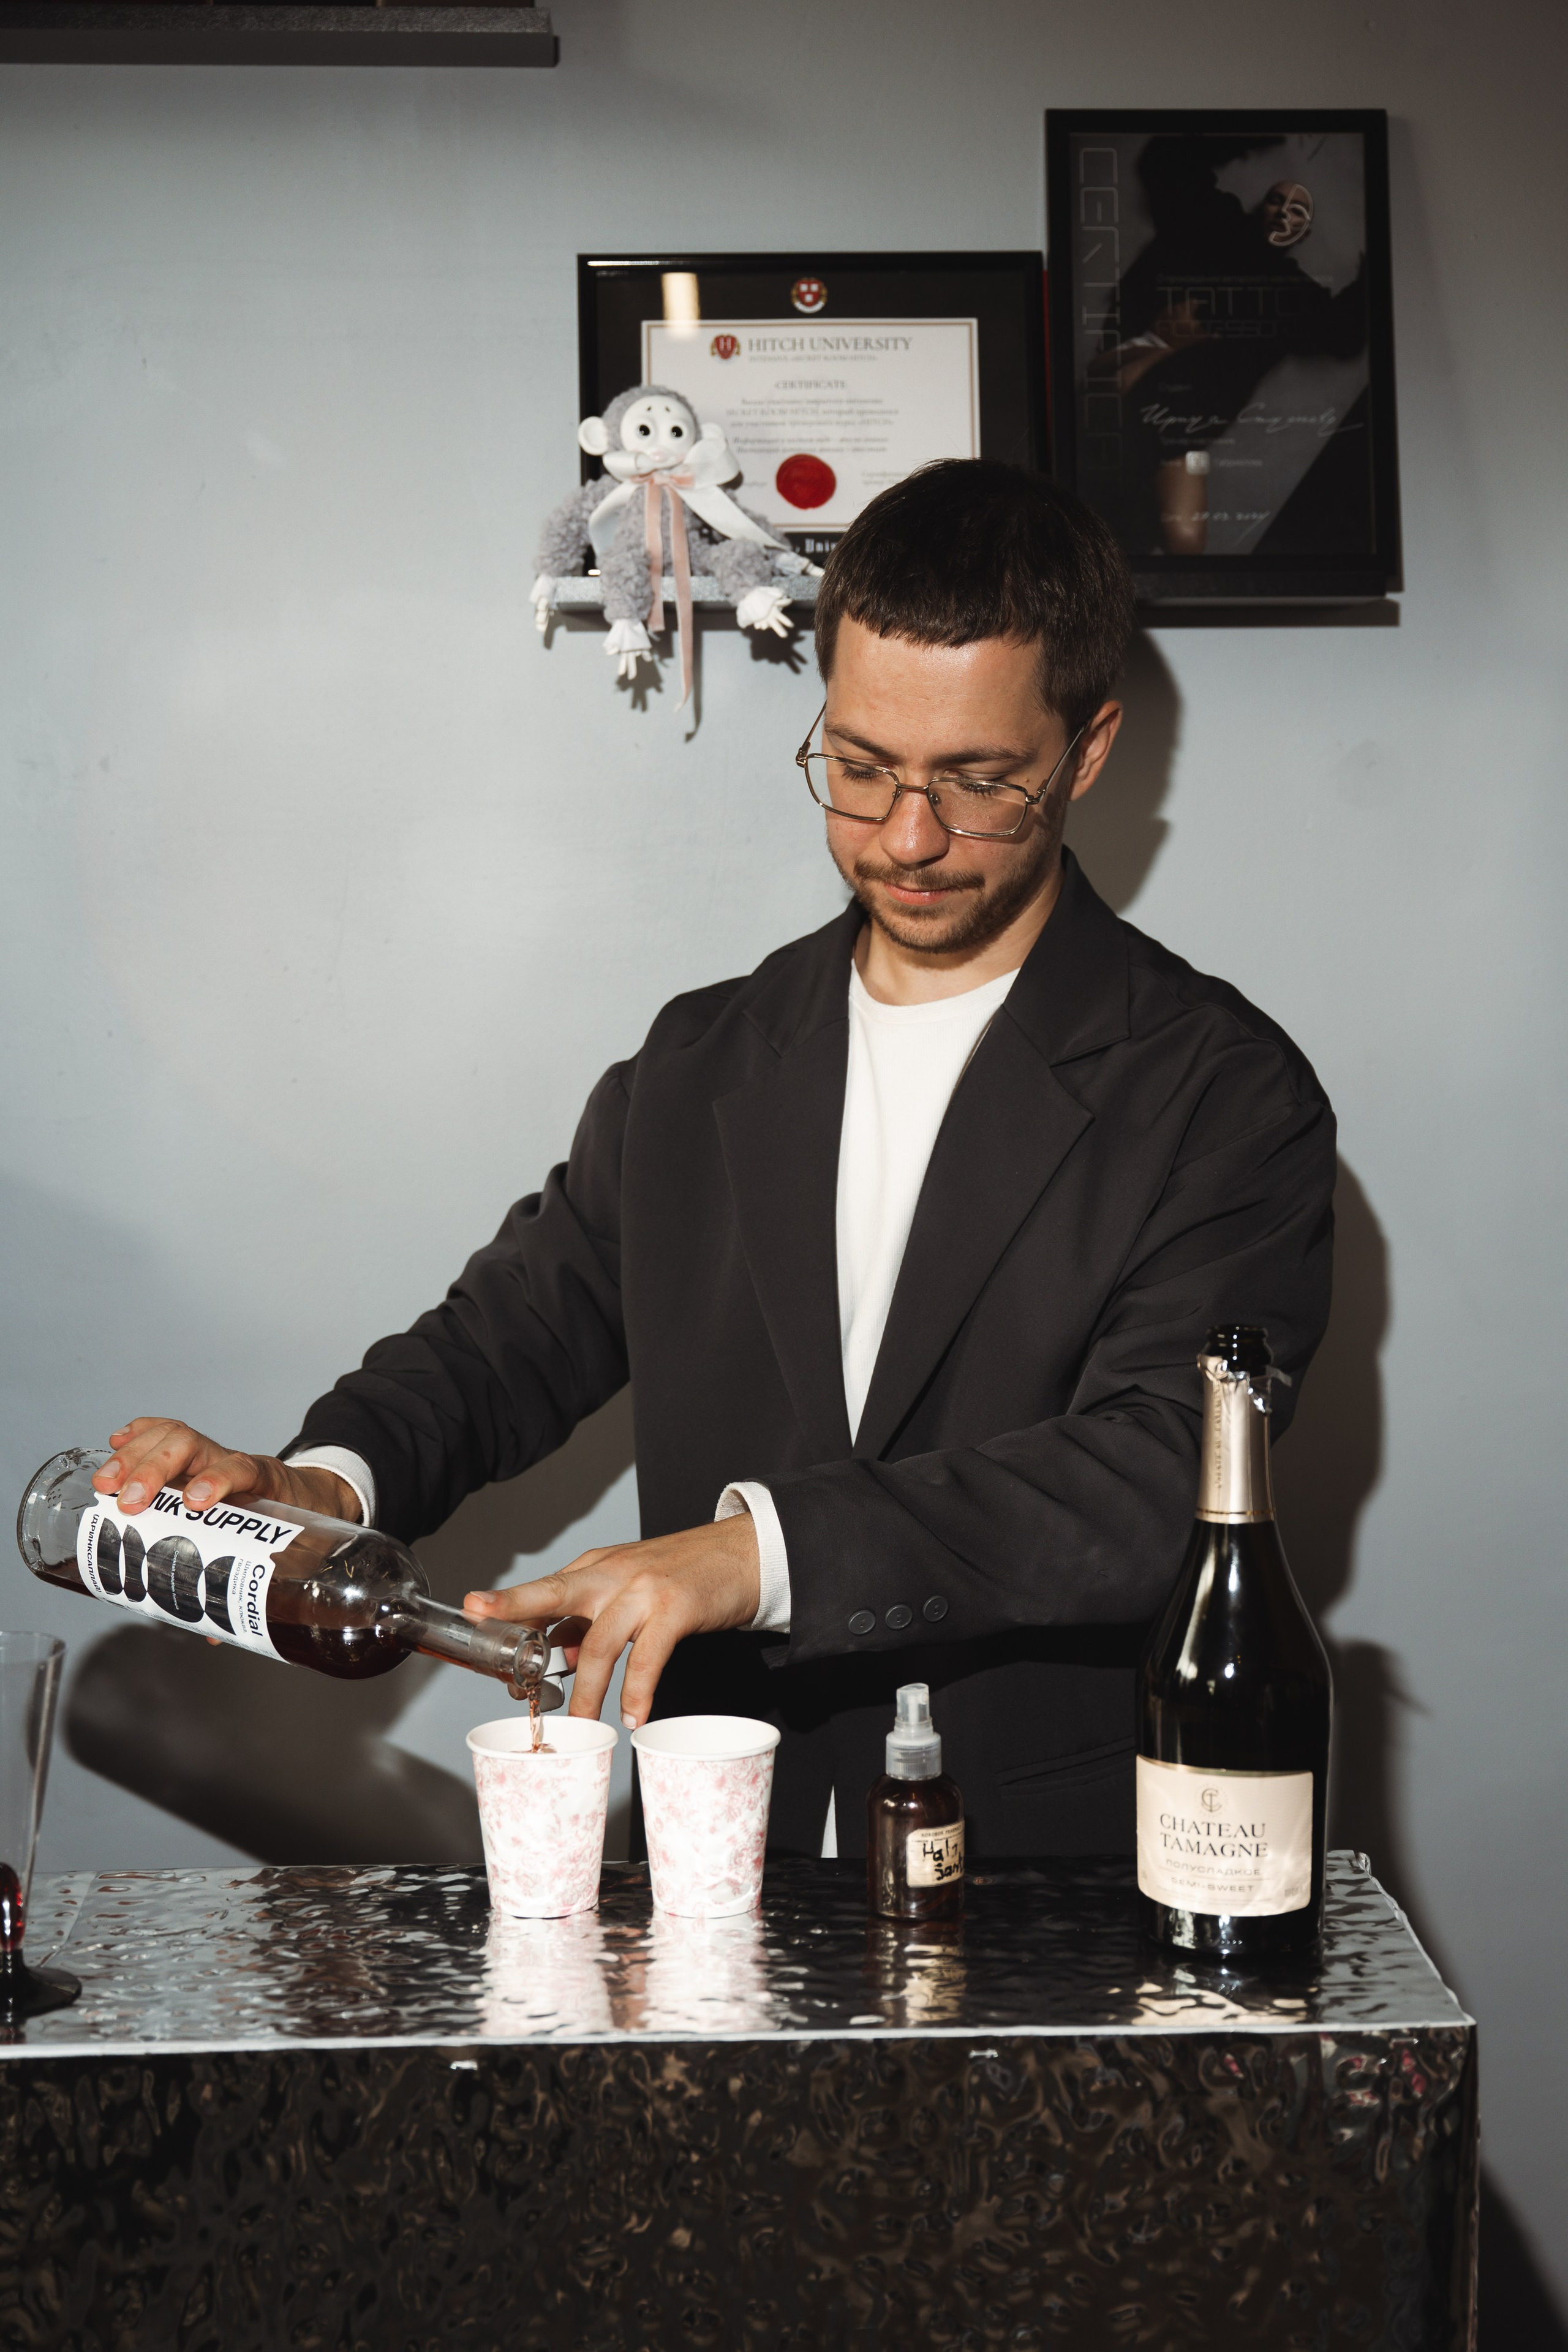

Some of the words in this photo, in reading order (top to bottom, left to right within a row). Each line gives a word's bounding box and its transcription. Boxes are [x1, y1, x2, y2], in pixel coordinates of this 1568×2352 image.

[748, 337, 804, 352] HITCH
[809, 336, 913, 352] UNIVERSITY
[247, 1564, 266, 1637] Cordial
[1159, 1812, 1266, 1839] CHATEAU
[1159, 1831, 1268, 1858] TAMAGNE
[1171, 1876, 1254, 1892] SEMI-SWEET
